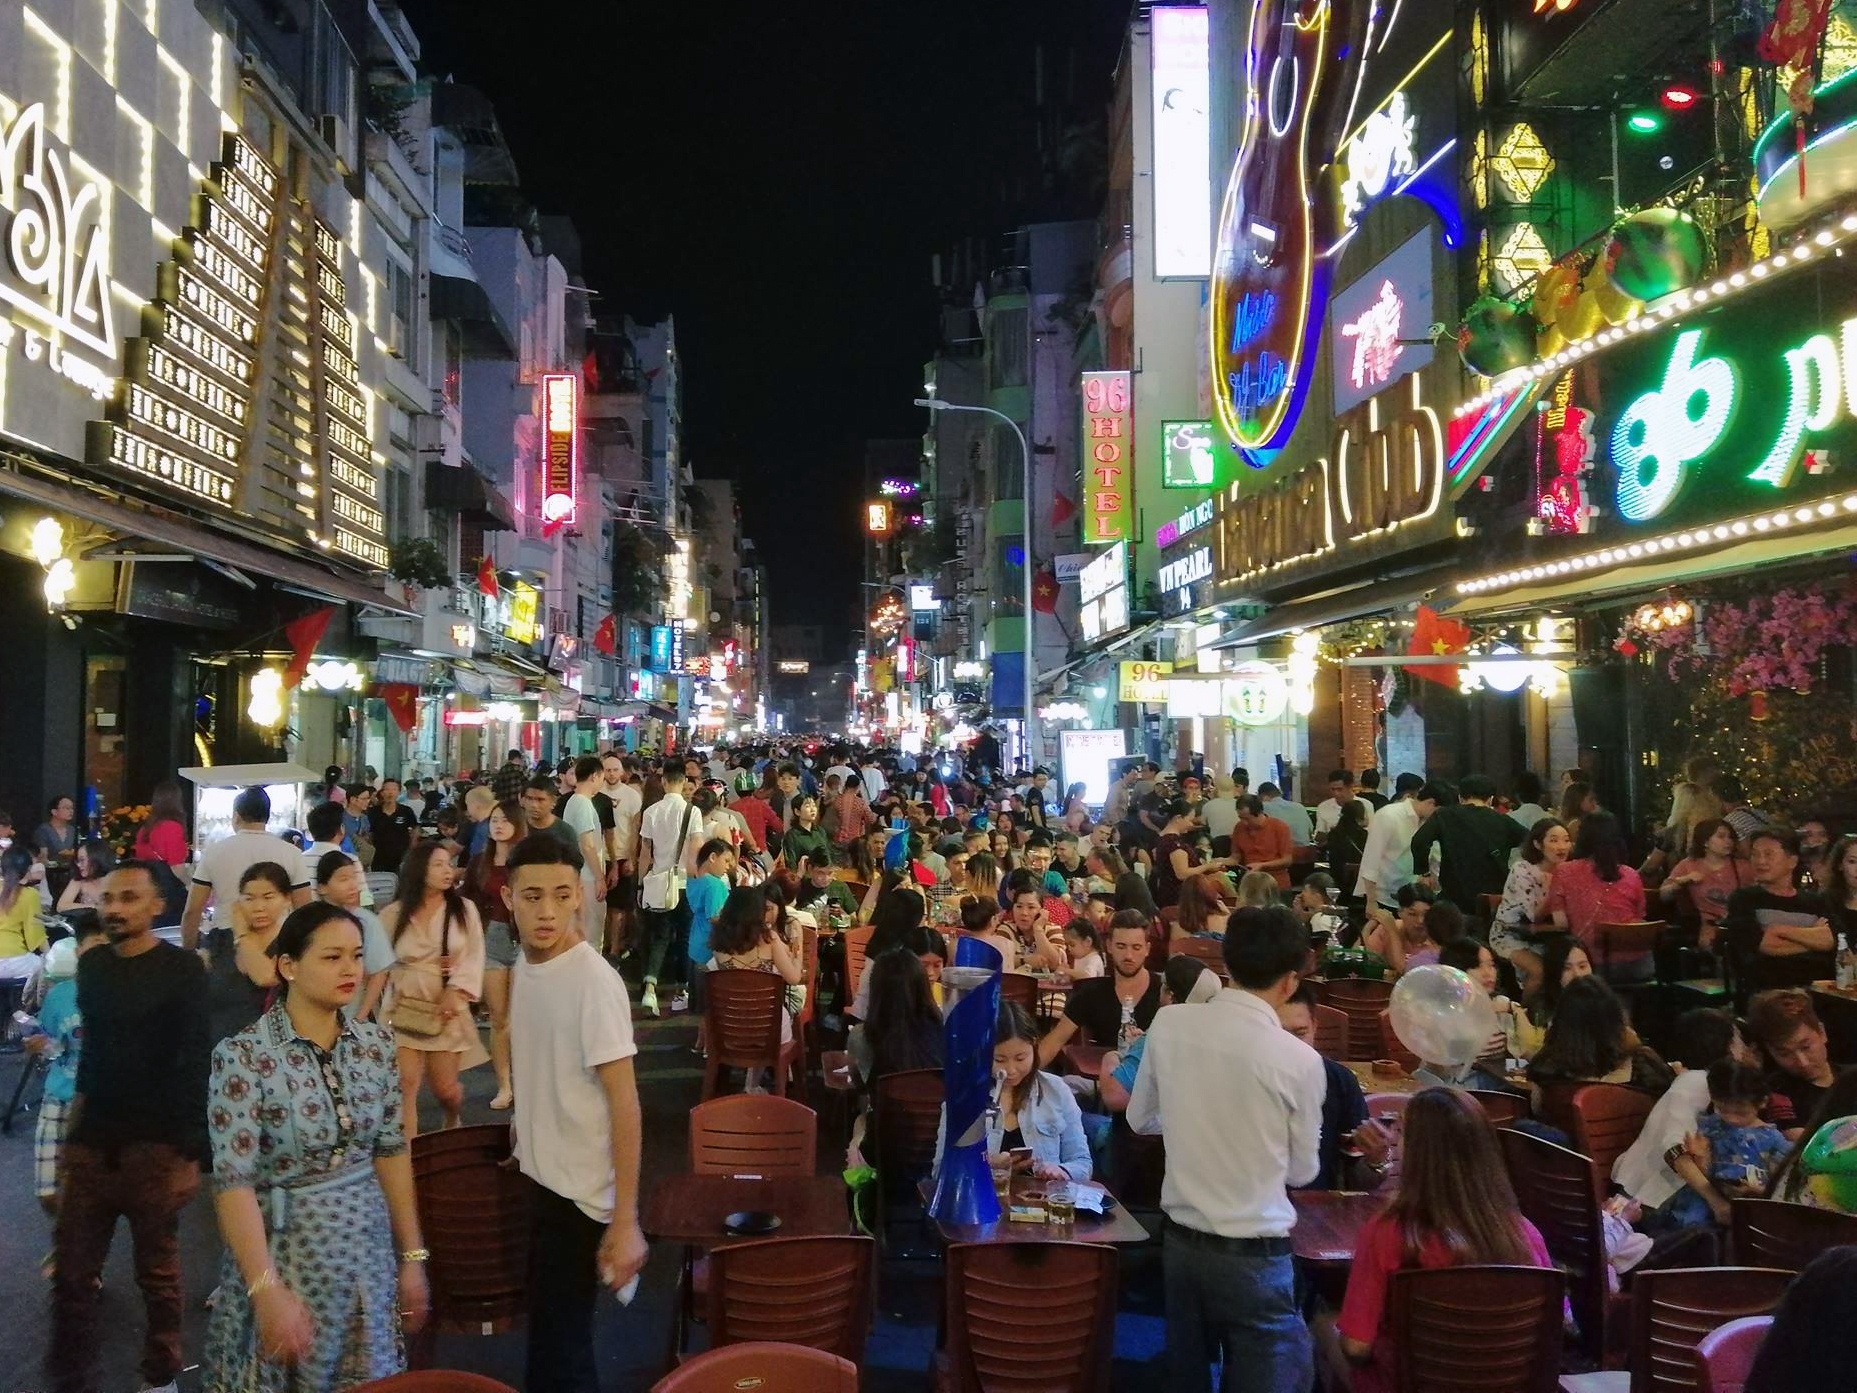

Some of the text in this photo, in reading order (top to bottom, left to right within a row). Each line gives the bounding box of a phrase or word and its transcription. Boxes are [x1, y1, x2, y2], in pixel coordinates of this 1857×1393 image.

[1086, 380, 1127, 413] 96
[551, 434, 569, 491] FLIPSIDE
[1090, 417, 1122, 537] HOTEL
[1132, 663, 1161, 683] 96
